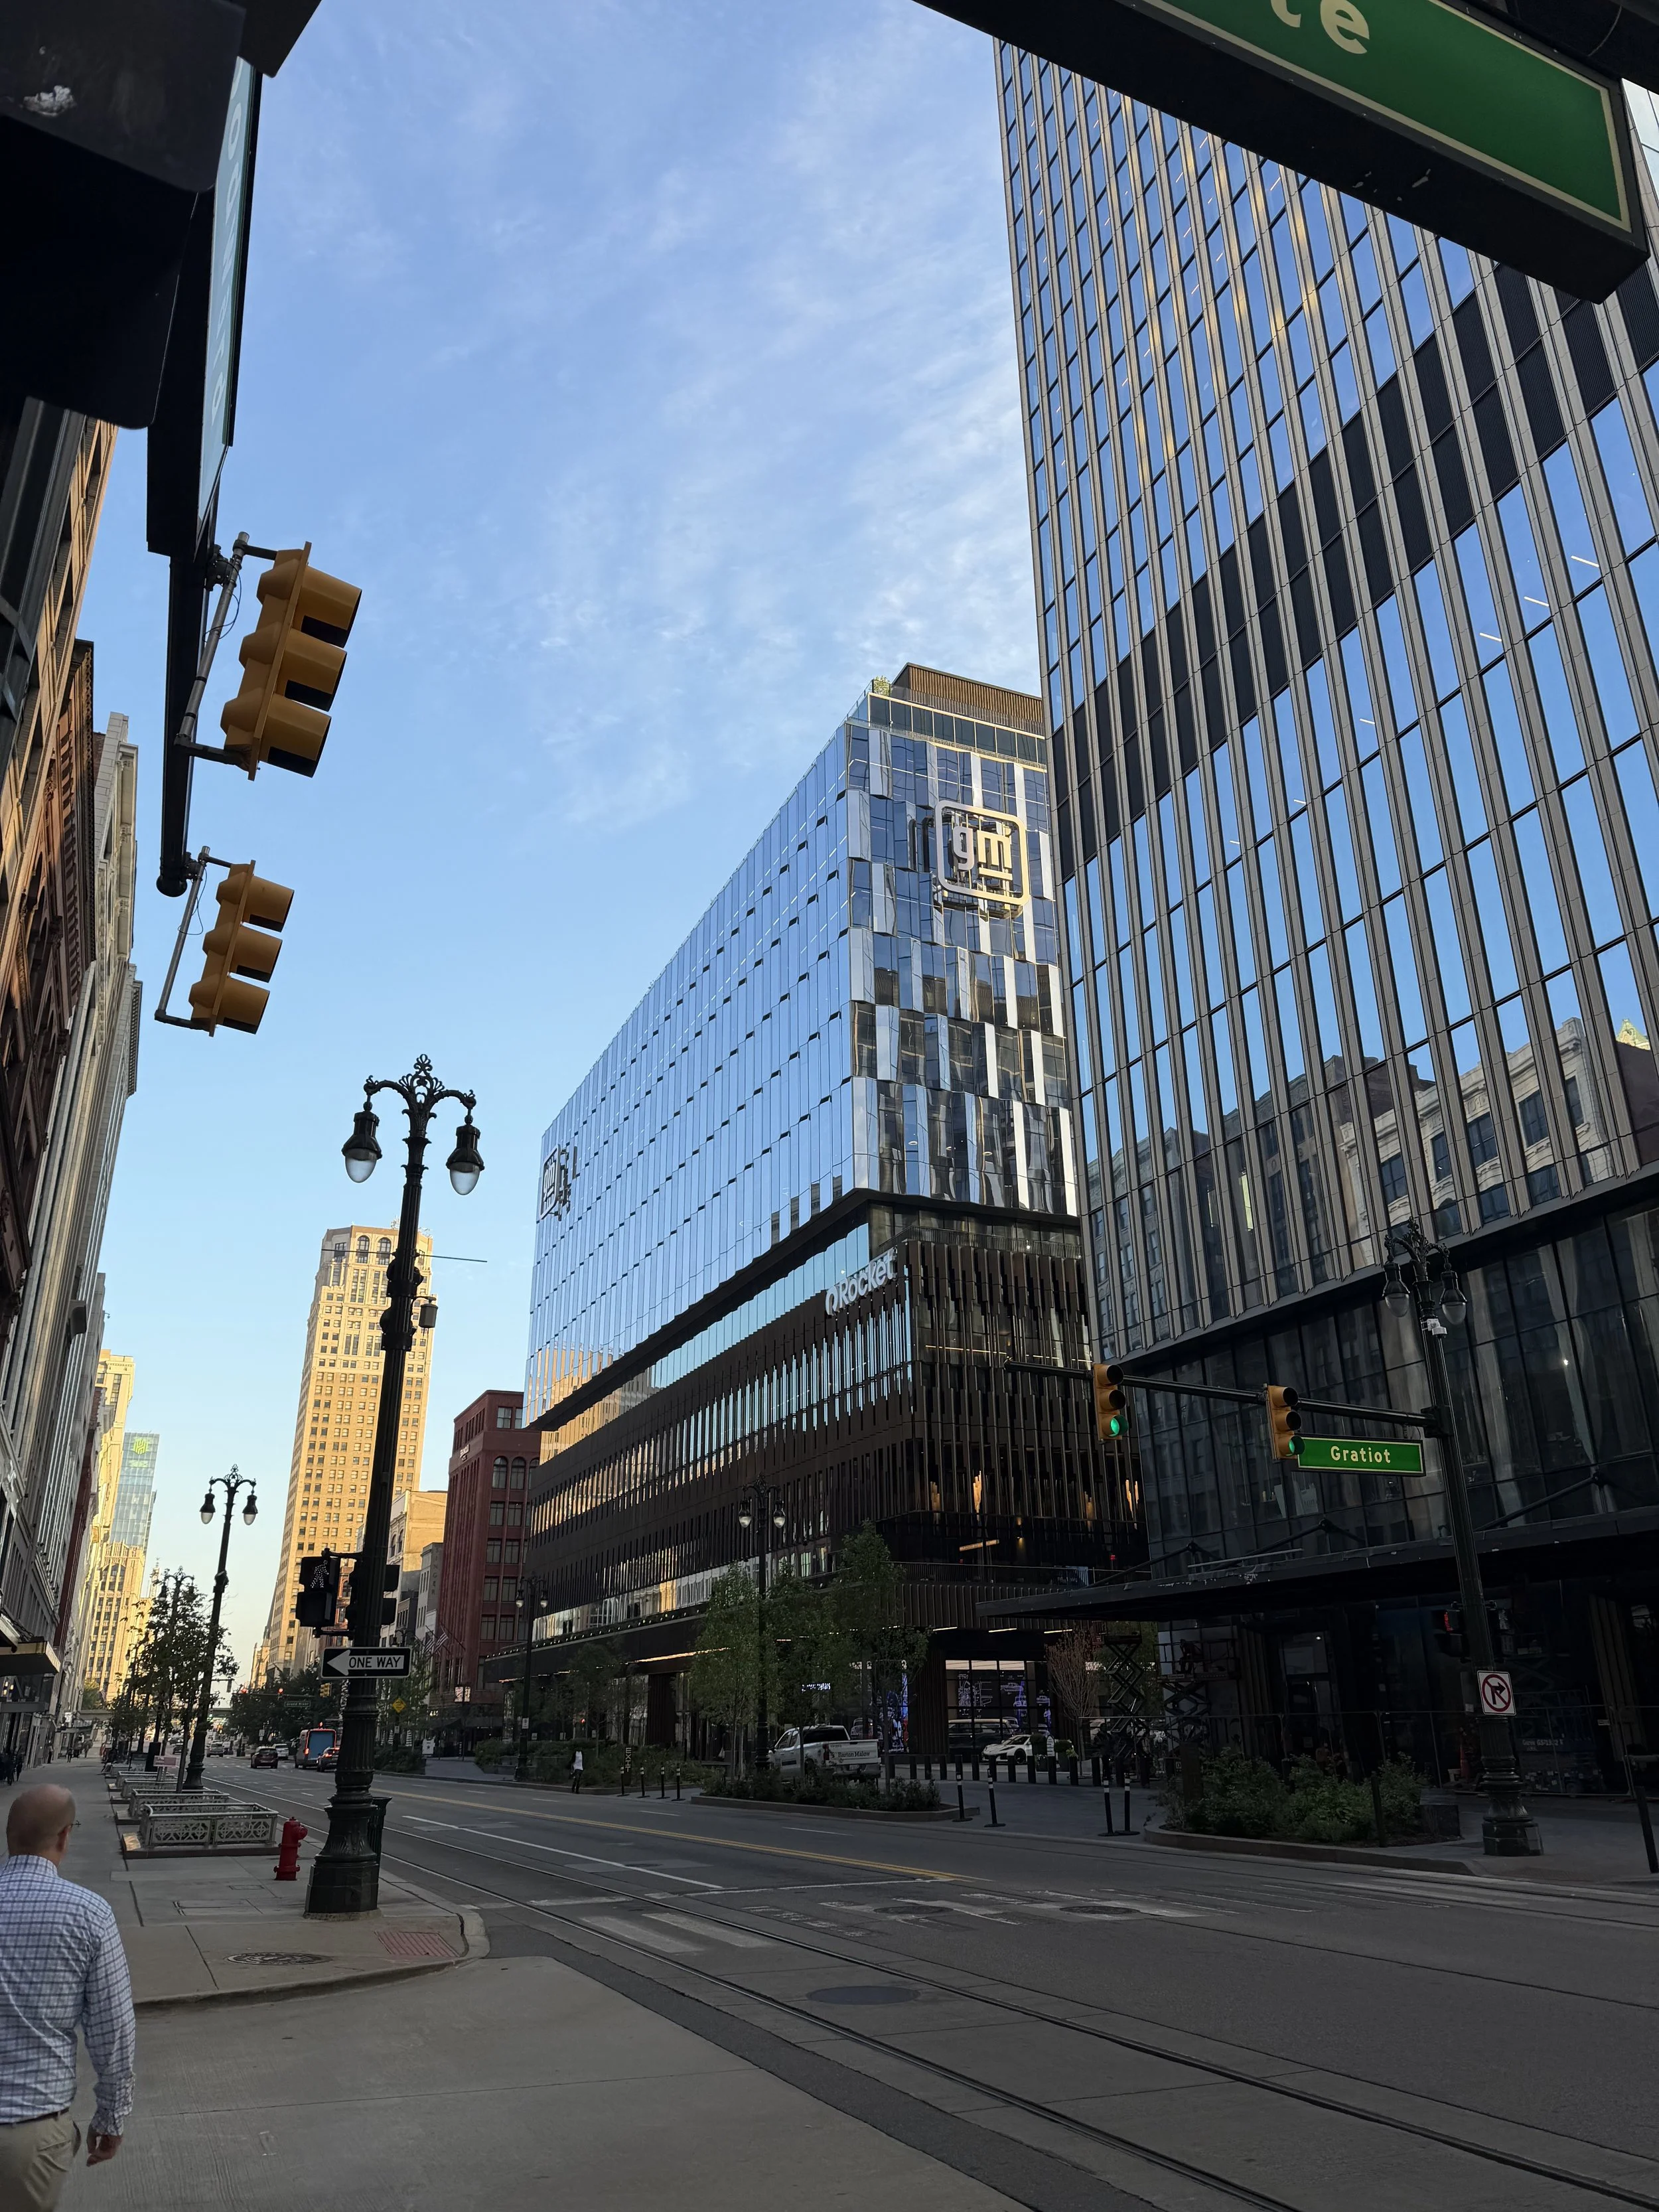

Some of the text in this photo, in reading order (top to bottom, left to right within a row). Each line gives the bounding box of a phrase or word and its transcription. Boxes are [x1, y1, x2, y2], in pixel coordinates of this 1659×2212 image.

[953, 826, 1013, 881] gm
[838, 1249, 896, 1309] Rocket
[1331, 1445, 1391, 1463] Gratiot
[348, 1656, 401, 1668] ONE WAY
